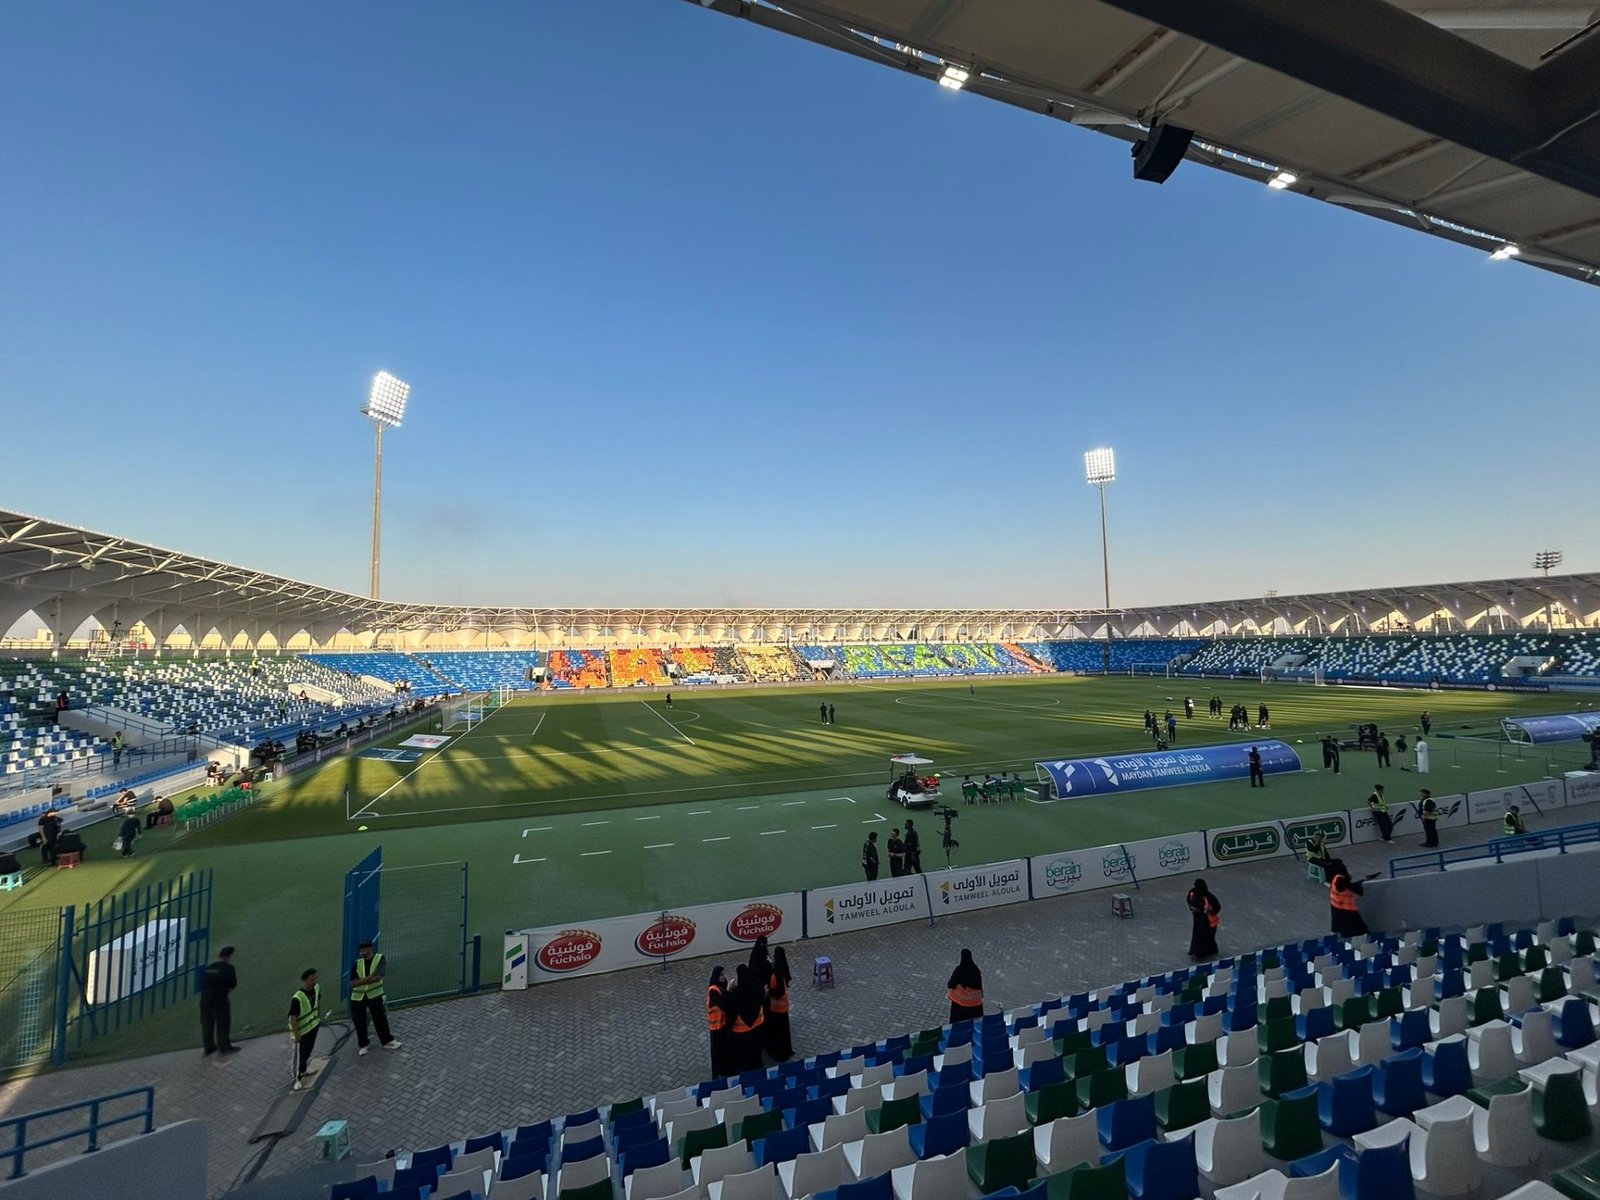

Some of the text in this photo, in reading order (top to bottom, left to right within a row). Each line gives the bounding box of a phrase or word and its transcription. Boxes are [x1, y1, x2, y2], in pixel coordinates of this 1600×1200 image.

[1149, 755, 1177, 768] تمويل
[1121, 764, 1211, 781] MAYDAN TAMWEEL ALOULA
[1158, 844, 1189, 859] berain
[1046, 861, 1081, 878] berain
[953, 870, 1019, 891] تمويل الأولى
[839, 886, 914, 909] تمويل الأولى
[954, 886, 1021, 902] TAMWEEL ALOULA
[840, 903, 915, 920] TAMWEEL ALOULA
[736, 913, 775, 928] فوشية
[547, 940, 593, 957] فوشية
